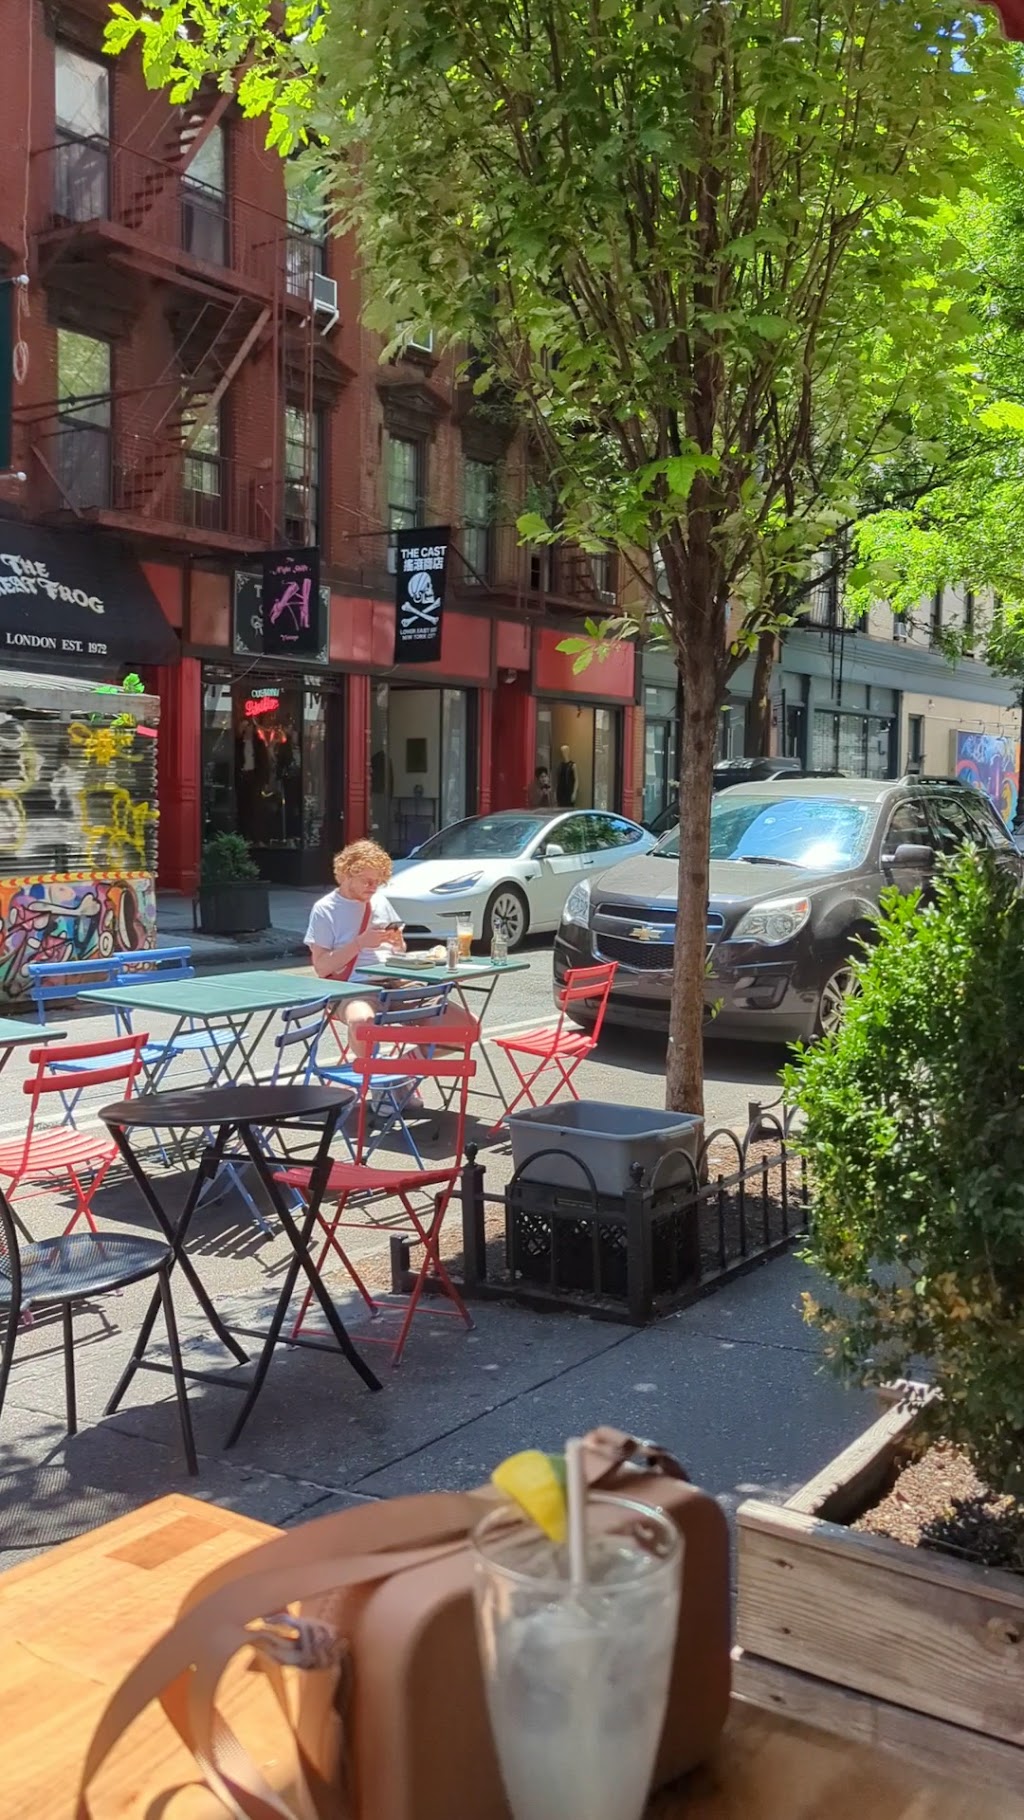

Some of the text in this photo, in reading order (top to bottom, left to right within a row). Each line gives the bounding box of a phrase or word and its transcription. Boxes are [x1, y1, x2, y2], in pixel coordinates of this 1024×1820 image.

[400, 545, 448, 560] THE CAST
[0, 553, 50, 578] THE
[37, 577, 106, 614] FROG
[5, 632, 108, 655] LONDON EST. 1972
